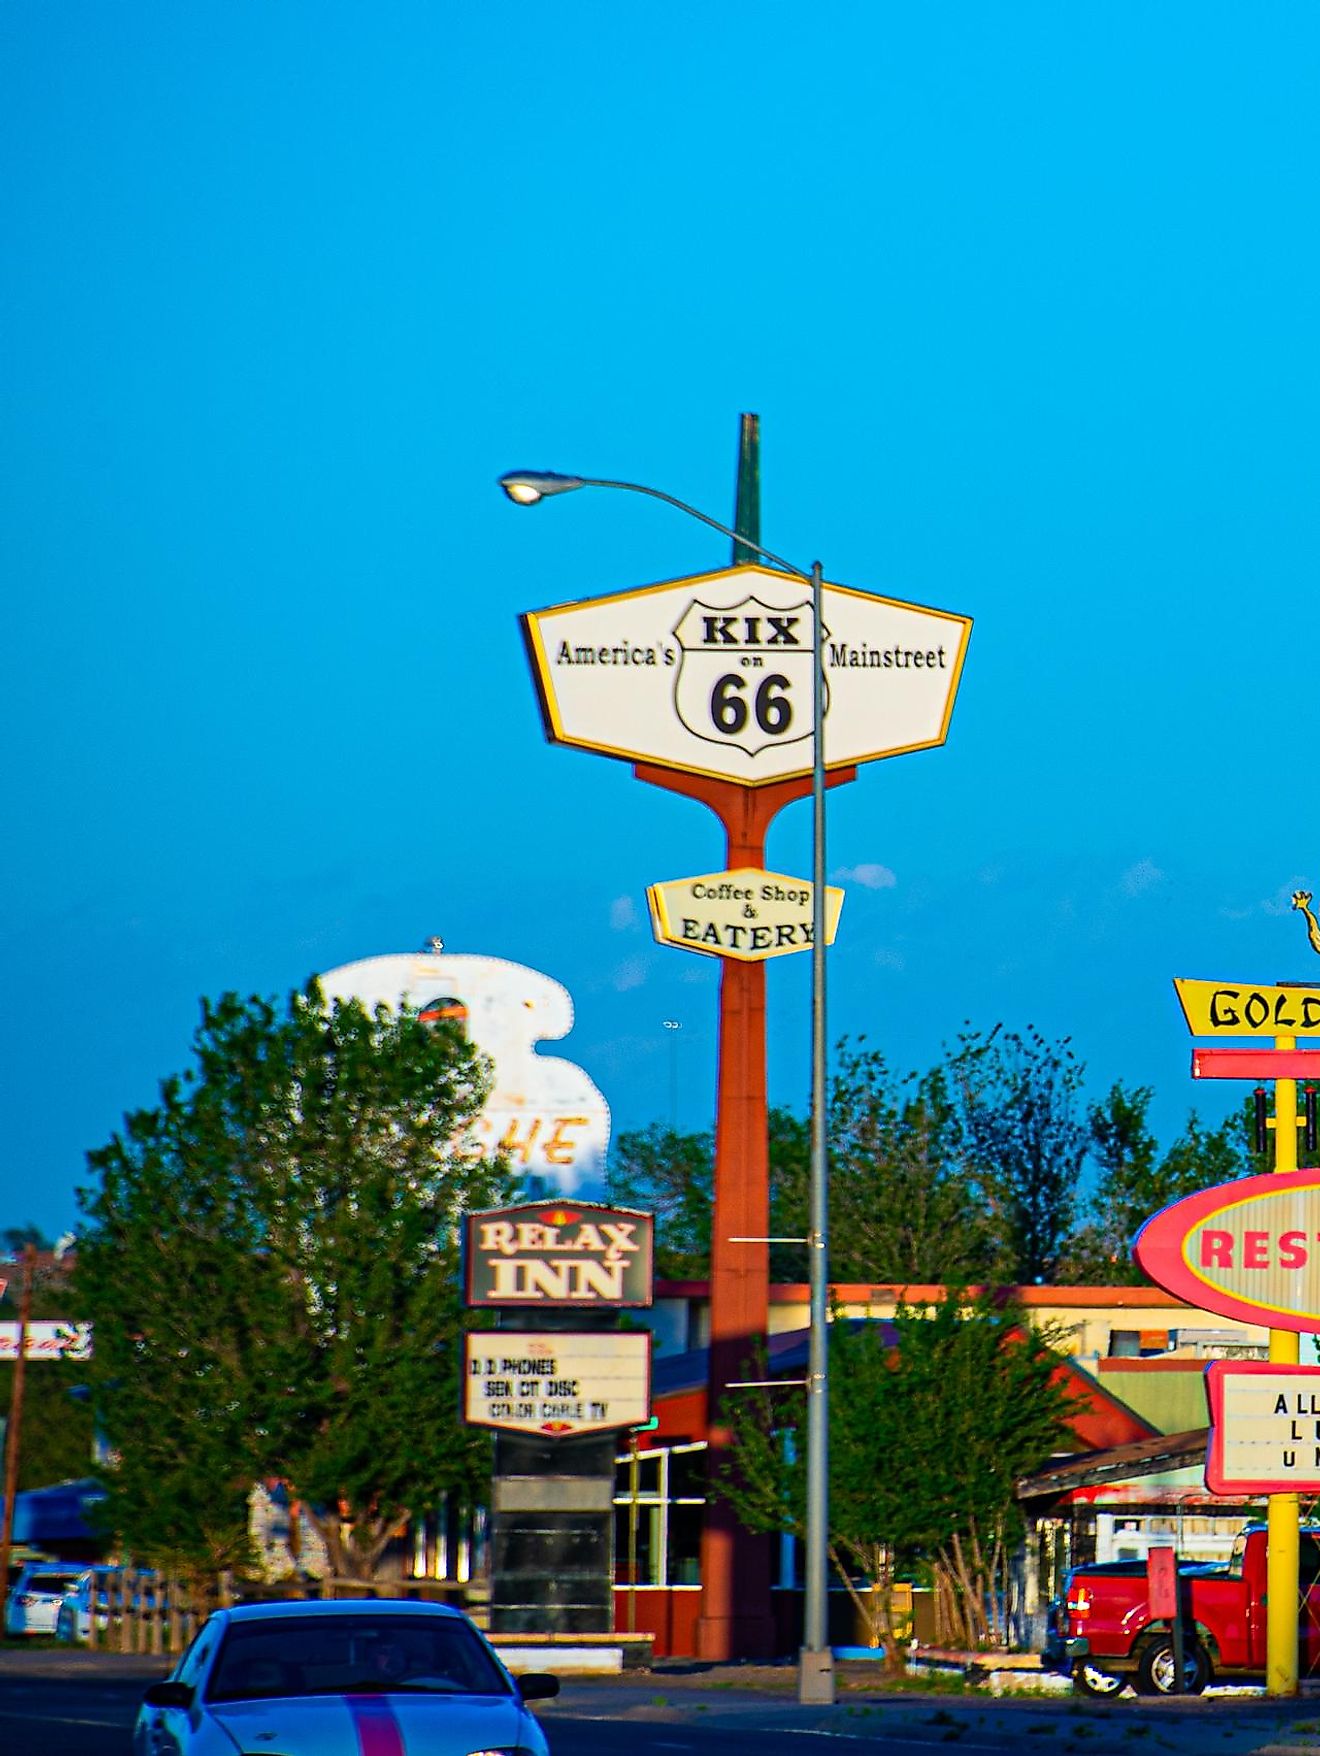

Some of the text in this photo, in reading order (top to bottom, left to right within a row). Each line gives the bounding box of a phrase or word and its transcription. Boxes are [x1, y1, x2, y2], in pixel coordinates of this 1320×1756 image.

[702, 616, 801, 645] KIX
[556, 640, 675, 666] America's
[739, 655, 764, 668] on
[829, 642, 947, 669] Mainstreet
[710, 673, 793, 735] 66
[692, 883, 811, 906] Coffee Shop
[743, 903, 758, 919] &
[682, 918, 816, 950] EATERY
[479, 1221, 640, 1260] RELAX
[486, 1258, 632, 1299] INN
[502, 1358, 557, 1376] PHONES
